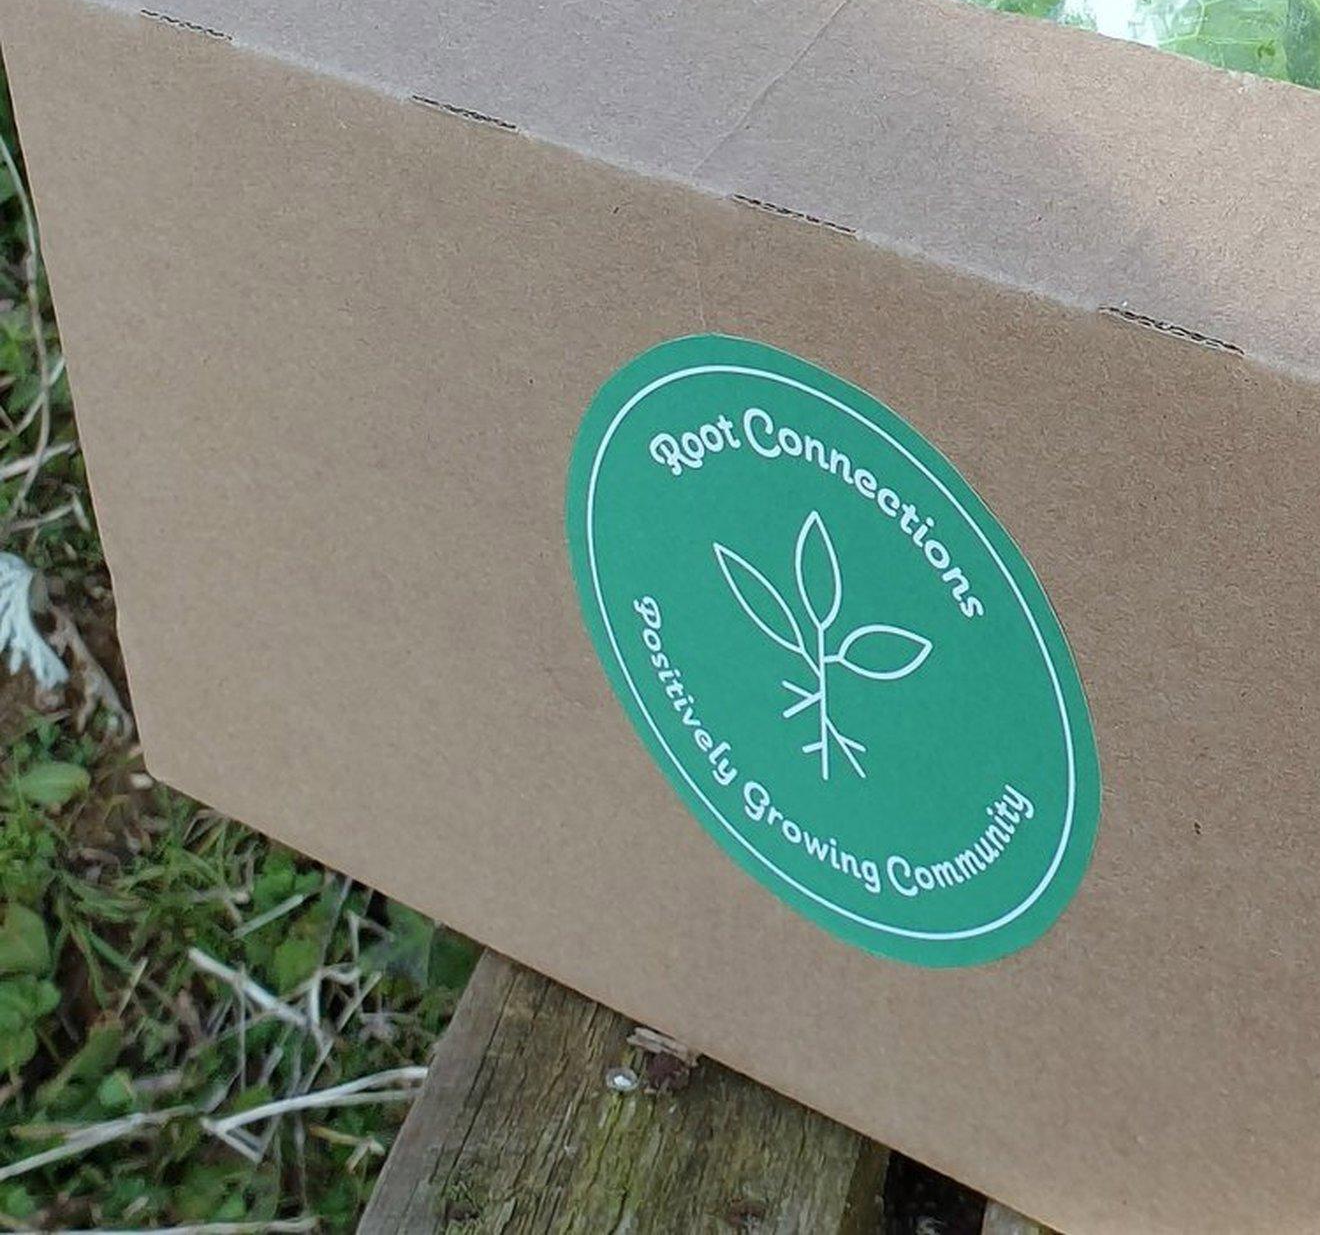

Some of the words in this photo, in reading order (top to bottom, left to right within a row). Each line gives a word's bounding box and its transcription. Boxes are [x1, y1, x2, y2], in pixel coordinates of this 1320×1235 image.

[649, 414, 742, 476] Root
[743, 407, 985, 620] Connections
[633, 595, 738, 787] Positively
[742, 780, 882, 894] Growing
[887, 782, 1035, 897] Community
